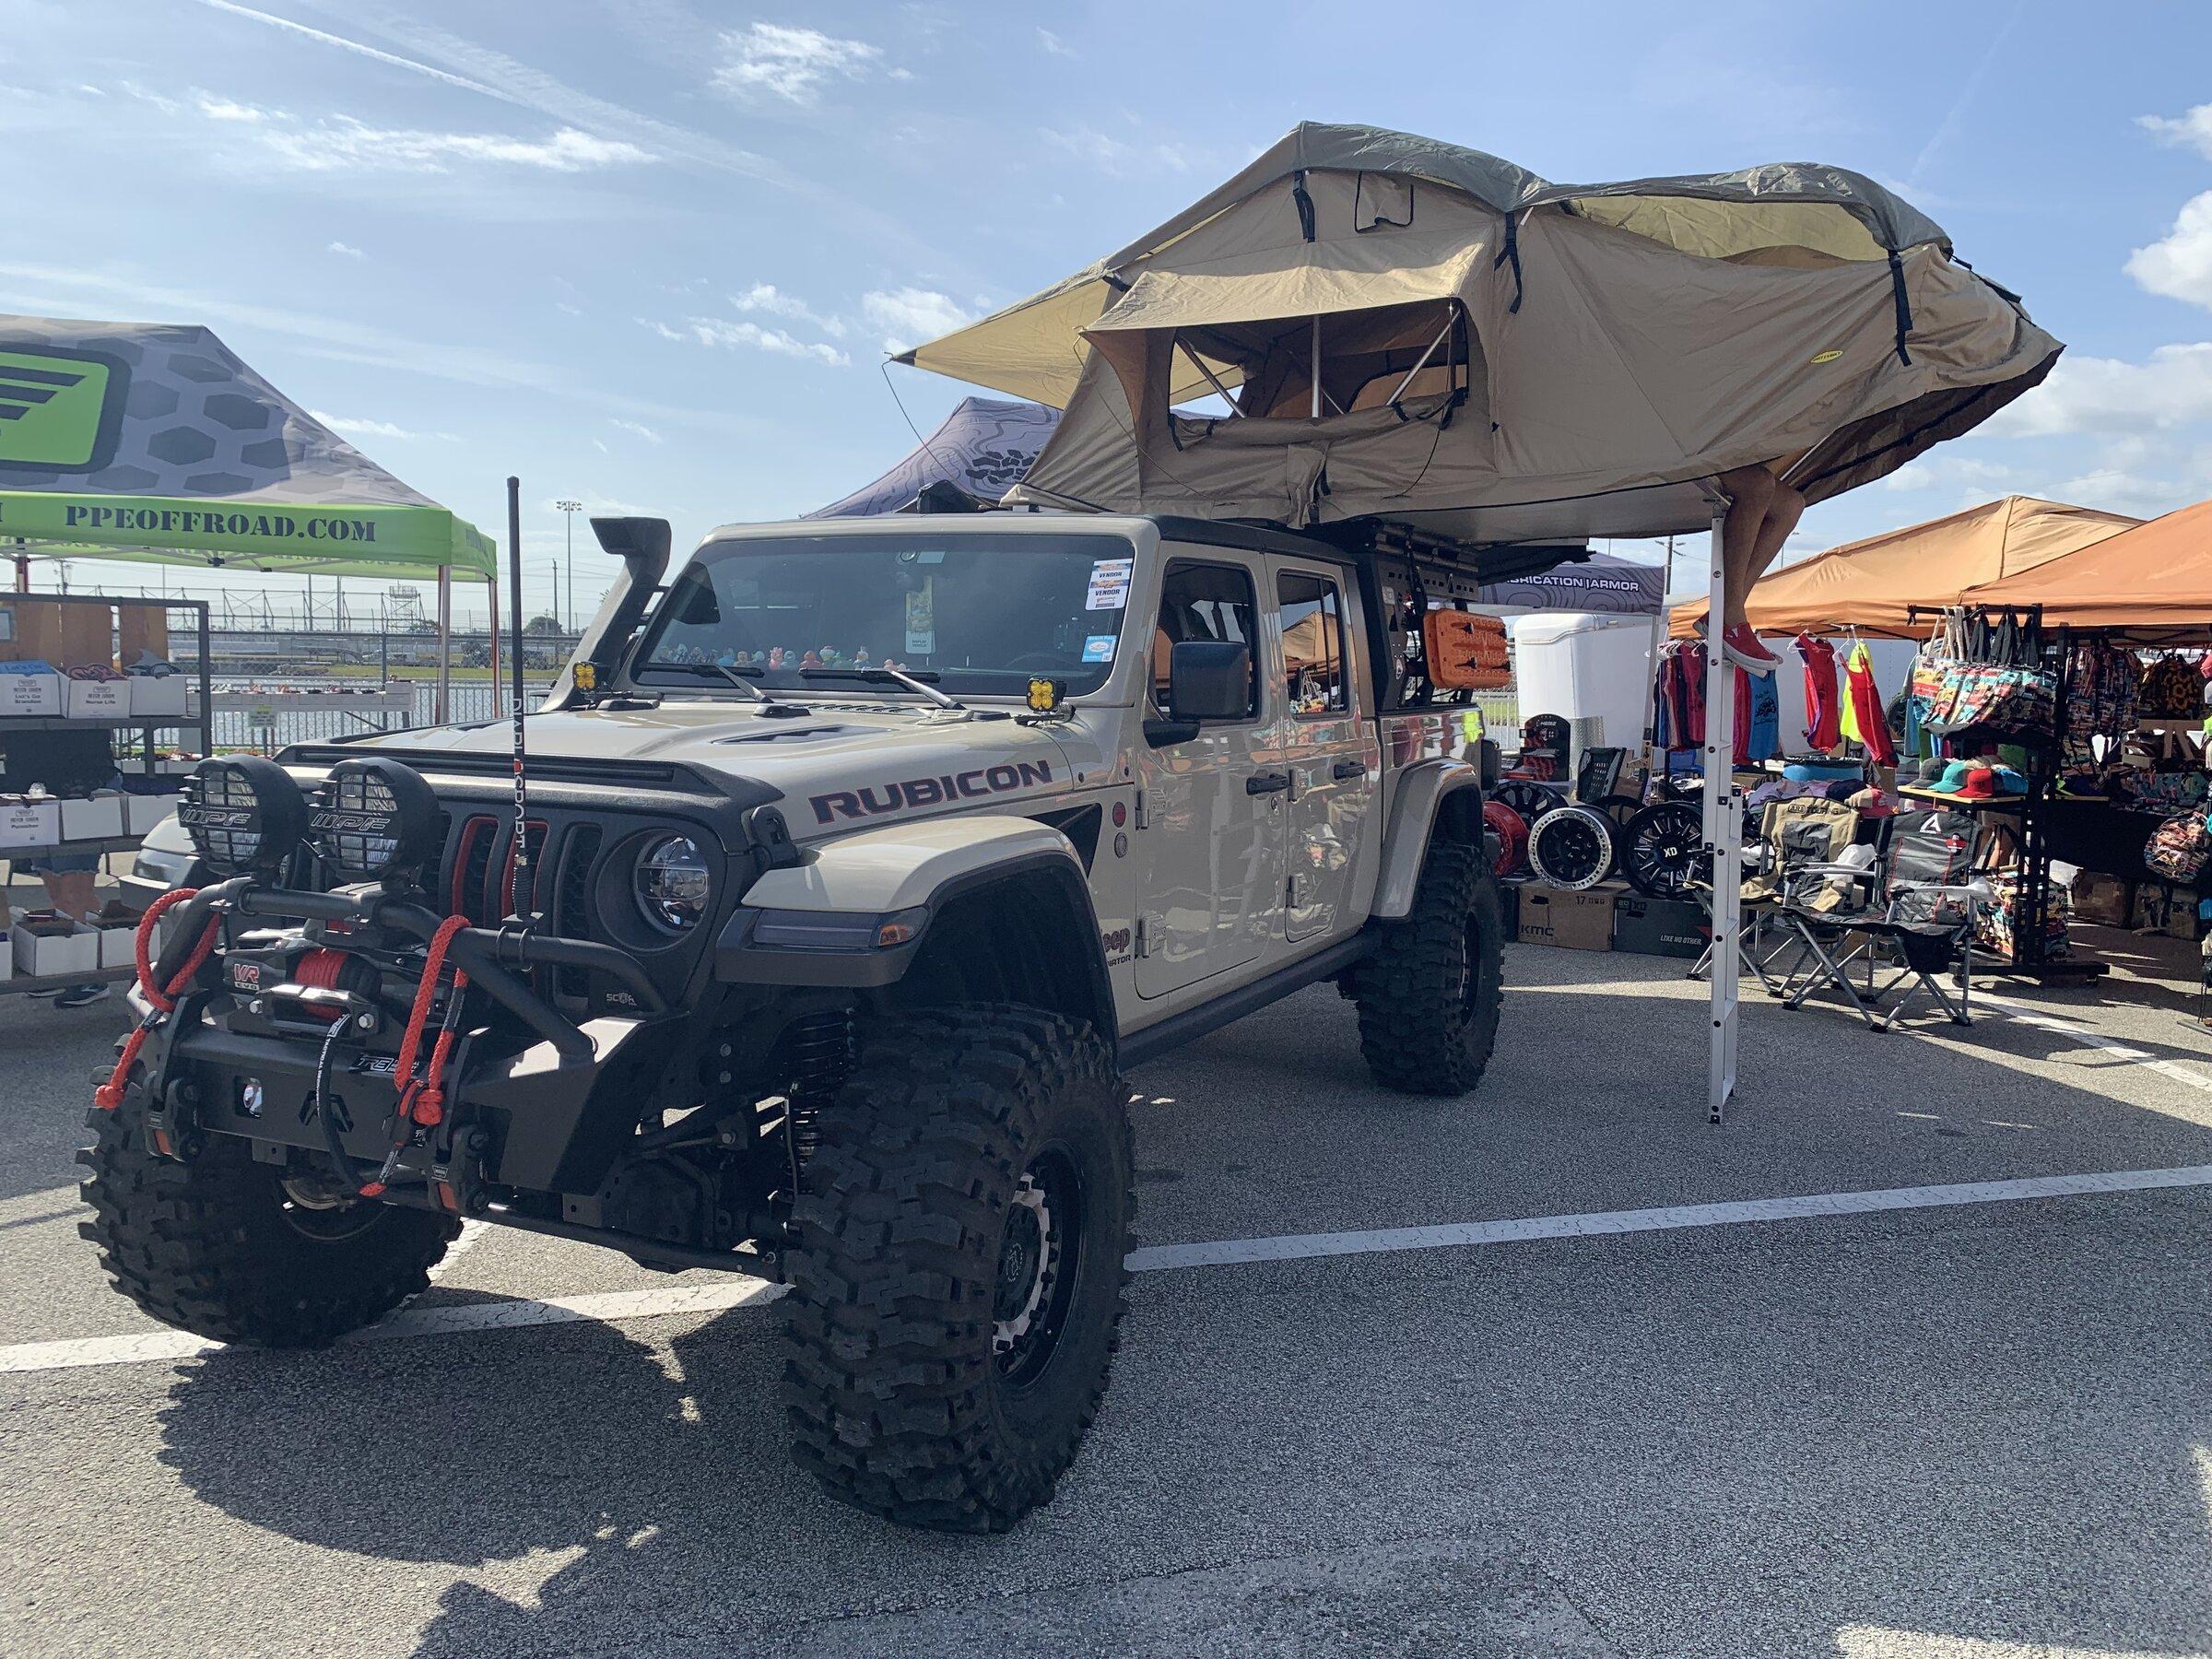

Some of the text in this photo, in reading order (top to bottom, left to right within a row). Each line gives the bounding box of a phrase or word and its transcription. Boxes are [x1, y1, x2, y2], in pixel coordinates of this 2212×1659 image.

[65, 505, 376, 542] PPEOFFROAD.COM
[808, 759, 1053, 824] RUBICON
[1664, 847, 1677, 857] XD
[1102, 927, 1131, 953] eep
[234, 963, 260, 983] VR
[236, 982, 258, 991] EVO
